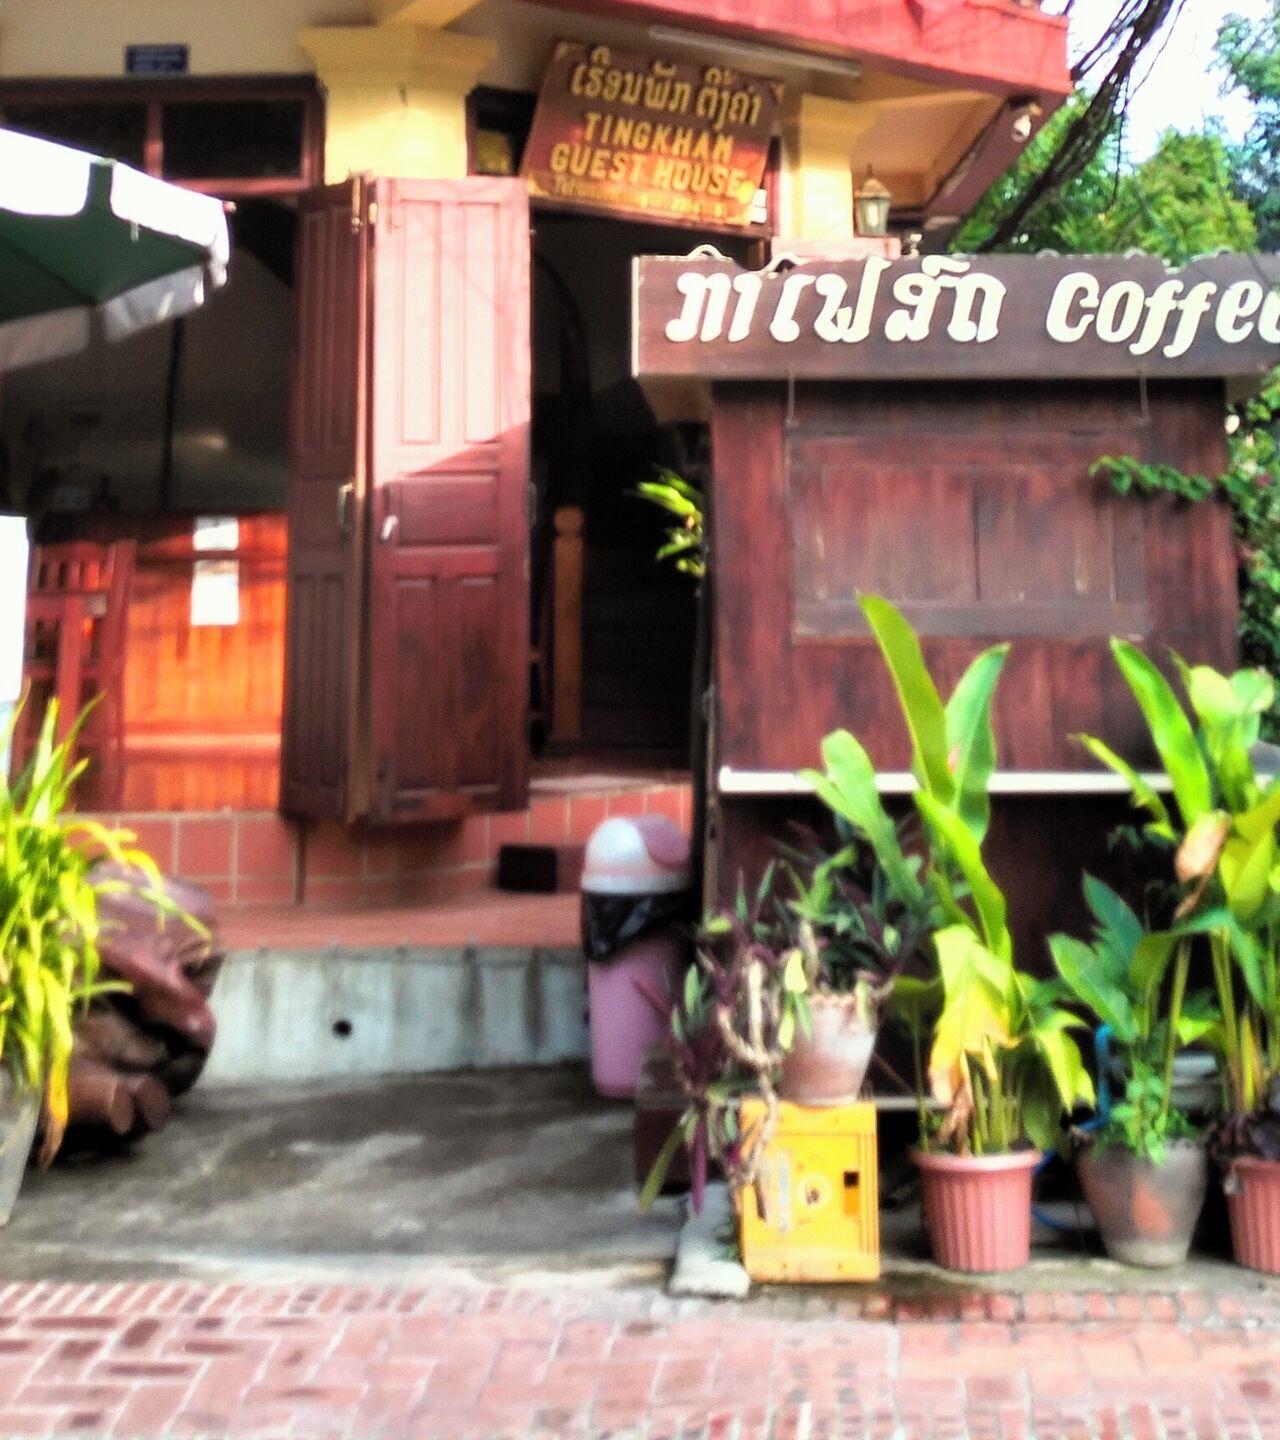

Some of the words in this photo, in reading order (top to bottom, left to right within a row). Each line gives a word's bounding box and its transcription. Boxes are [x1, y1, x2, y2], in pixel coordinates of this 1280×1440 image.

[583, 112, 735, 164] TINGKHAM
[550, 143, 648, 184] GUEST
[652, 157, 747, 203] HOUSE
